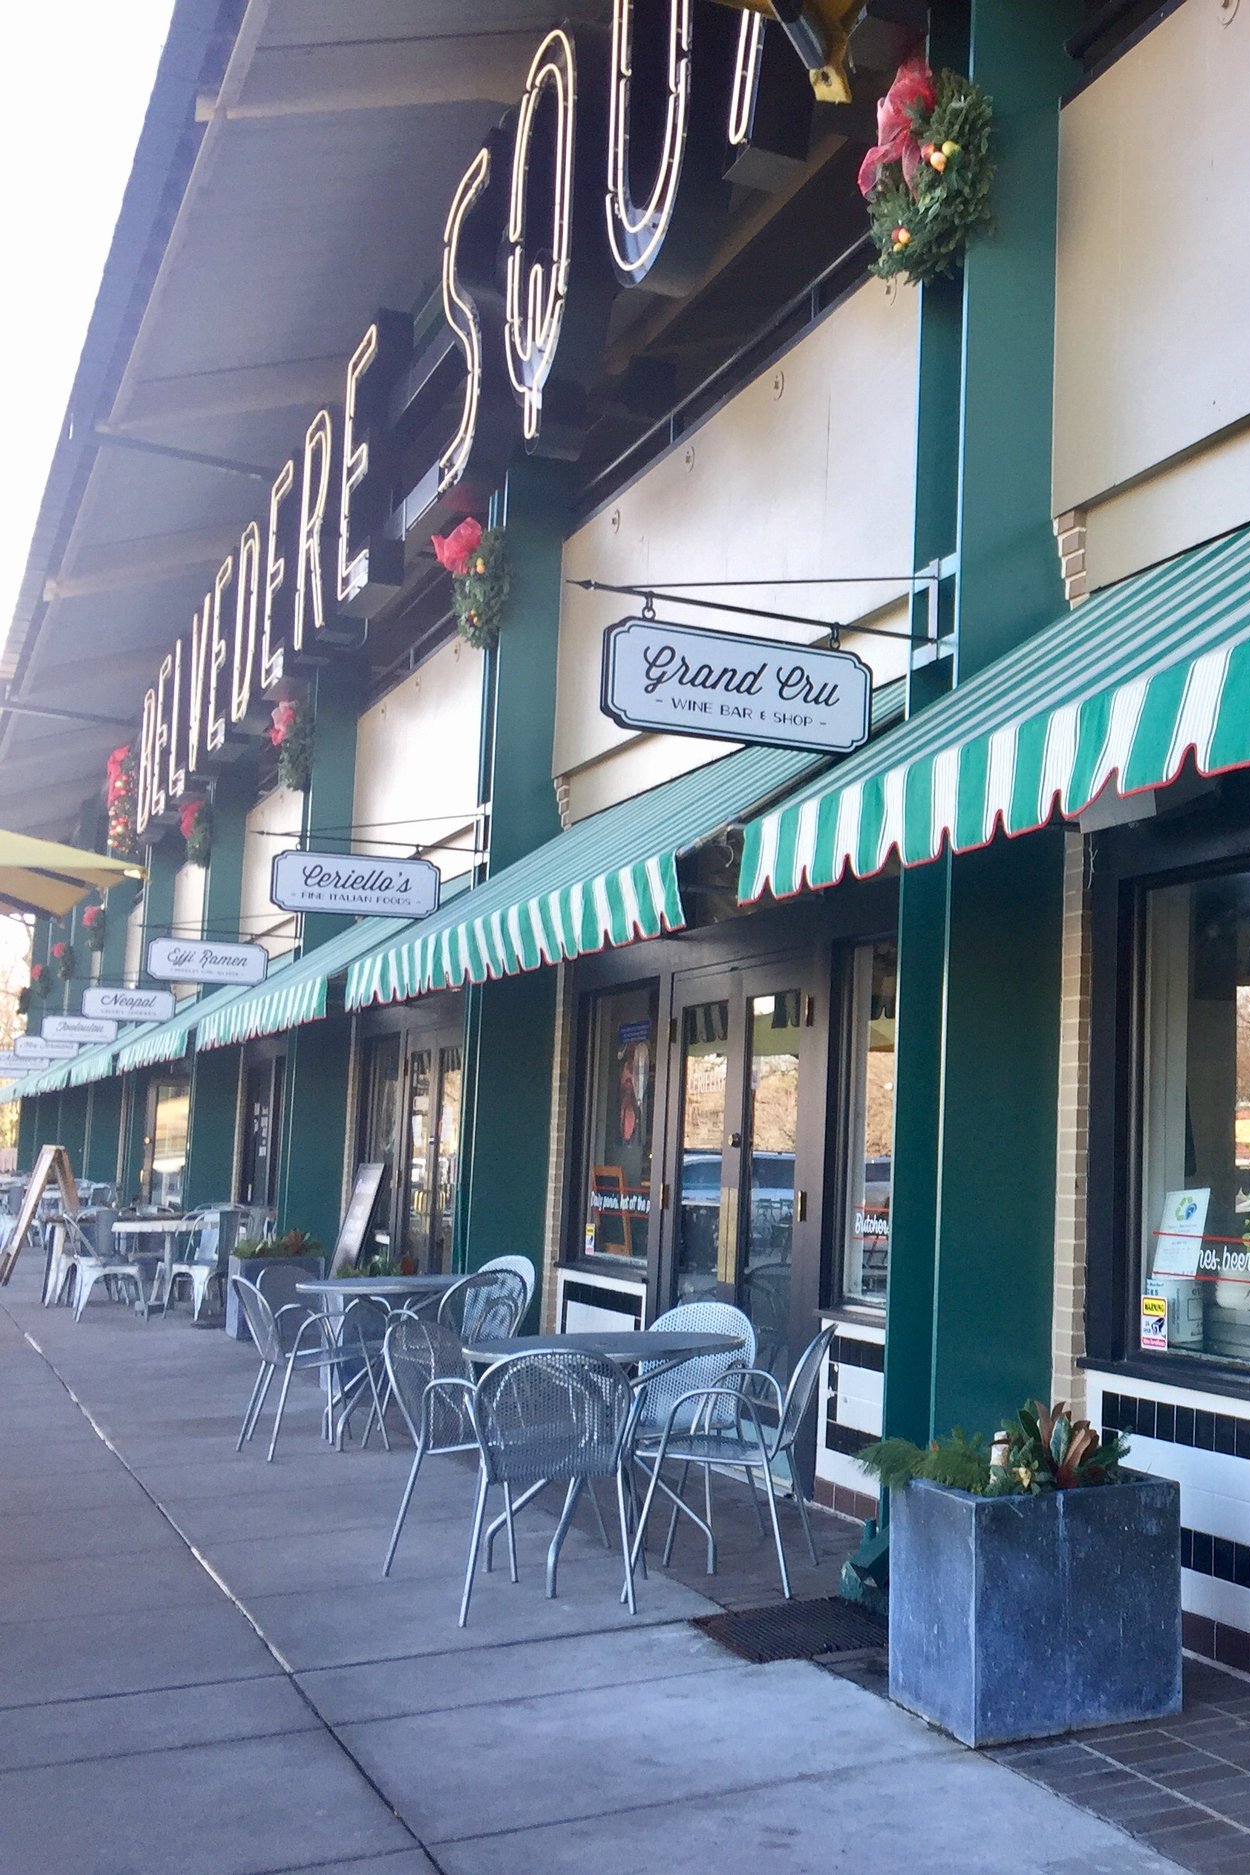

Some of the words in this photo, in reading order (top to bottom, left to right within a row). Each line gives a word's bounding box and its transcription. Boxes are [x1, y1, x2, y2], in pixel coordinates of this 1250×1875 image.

[136, 323, 378, 835] BELVEDERE
[438, 0, 762, 493] SQU
[643, 645, 769, 695] Grand
[776, 665, 841, 707] Cru
[671, 697, 713, 715] WINE
[720, 704, 753, 721] BAR
[773, 712, 813, 727] SHOP
[302, 864, 412, 893] Ceriello's
[301, 891, 324, 901] FINE
[329, 894, 372, 904] ITALIAN
[376, 896, 412, 906] FOODS
[199, 949, 249, 968] Ramen
